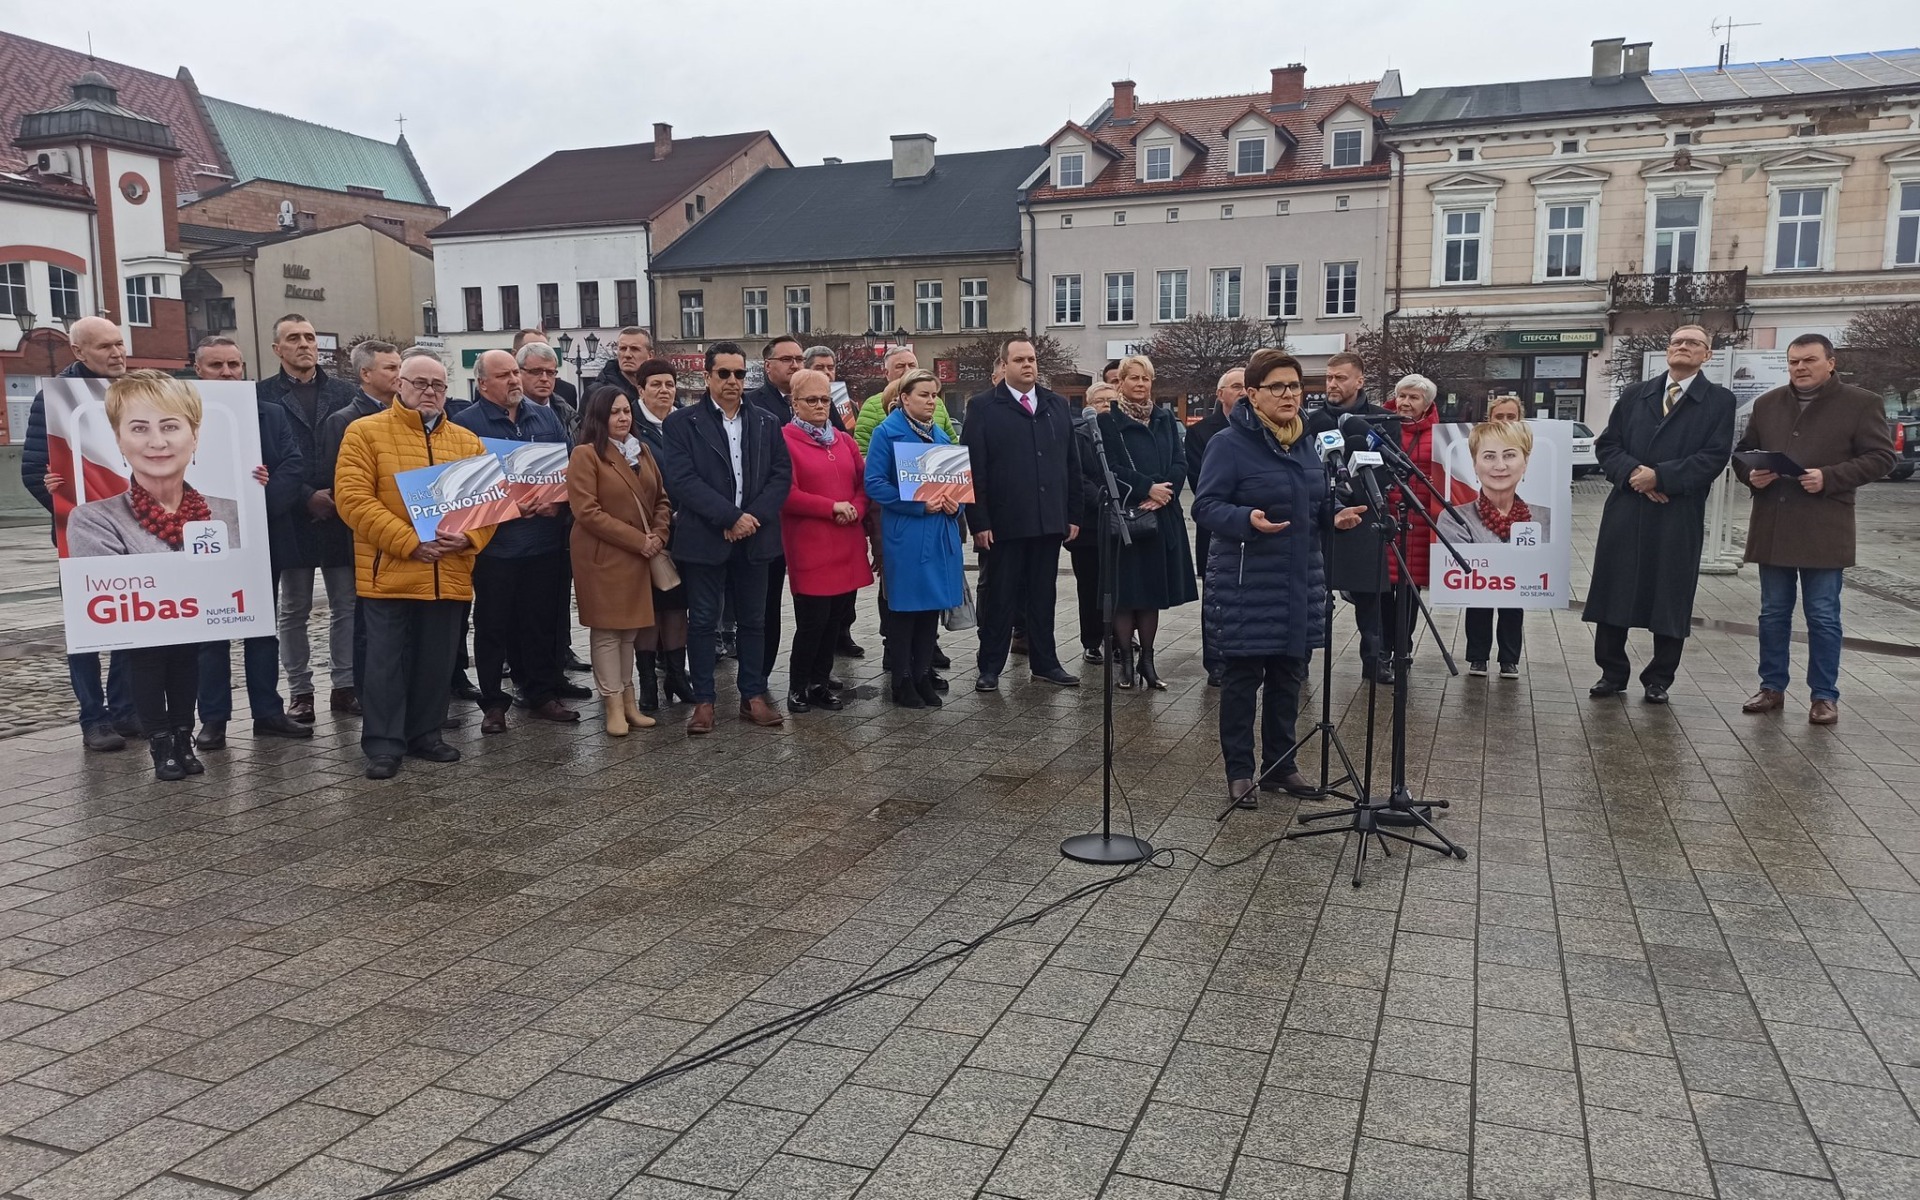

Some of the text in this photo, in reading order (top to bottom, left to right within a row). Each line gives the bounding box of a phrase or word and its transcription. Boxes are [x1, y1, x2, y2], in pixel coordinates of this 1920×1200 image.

[283, 263, 311, 280] Willa
[285, 283, 326, 301] Pierrot
[1522, 334, 1558, 342] STEFCZYK
[1562, 333, 1593, 341] FINANSE
[508, 471, 567, 485] ewoźnik
[899, 470, 970, 485] Przewoźnik
[408, 486, 442, 501] Jakub
[409, 485, 509, 520] Przewoźnik
[193, 541, 221, 555] PiS
[1516, 536, 1536, 546] PiS
[85, 575, 156, 592] Iwona
[1443, 569, 1516, 590] Gibas
[1539, 573, 1548, 590] 1
[87, 592, 199, 625] Gibas
[206, 589, 245, 616] NUMER 1
[207, 615, 255, 625] DO SEJMIKU
